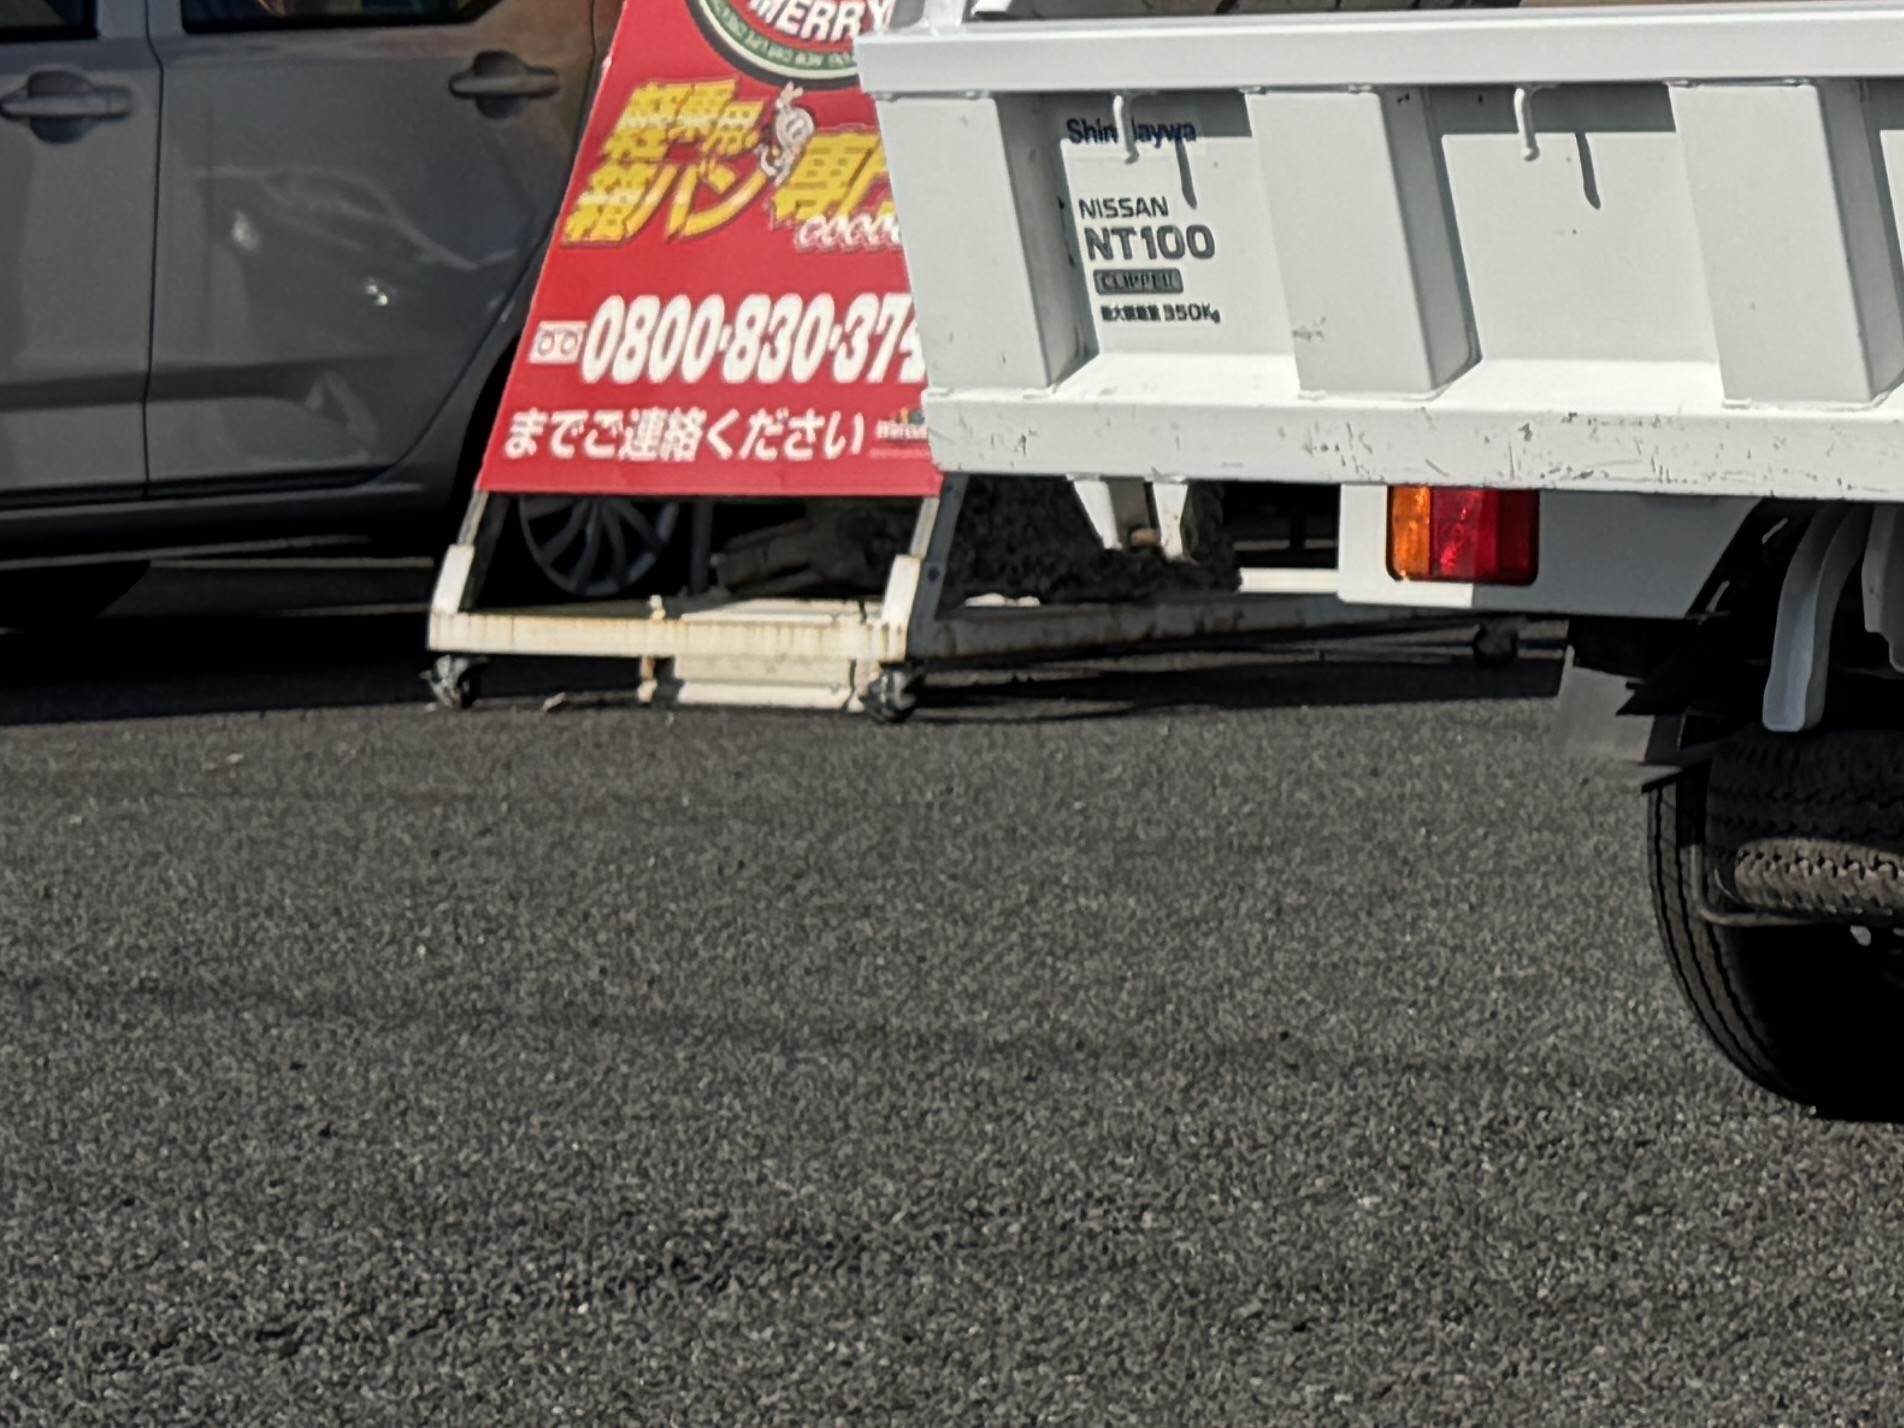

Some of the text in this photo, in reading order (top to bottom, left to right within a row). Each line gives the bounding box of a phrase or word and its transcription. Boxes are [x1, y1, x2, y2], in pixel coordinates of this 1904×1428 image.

[1078, 196, 1169, 220] NISSAN
[1083, 224, 1216, 261] NT100
[504, 405, 865, 462] までご連絡ください
